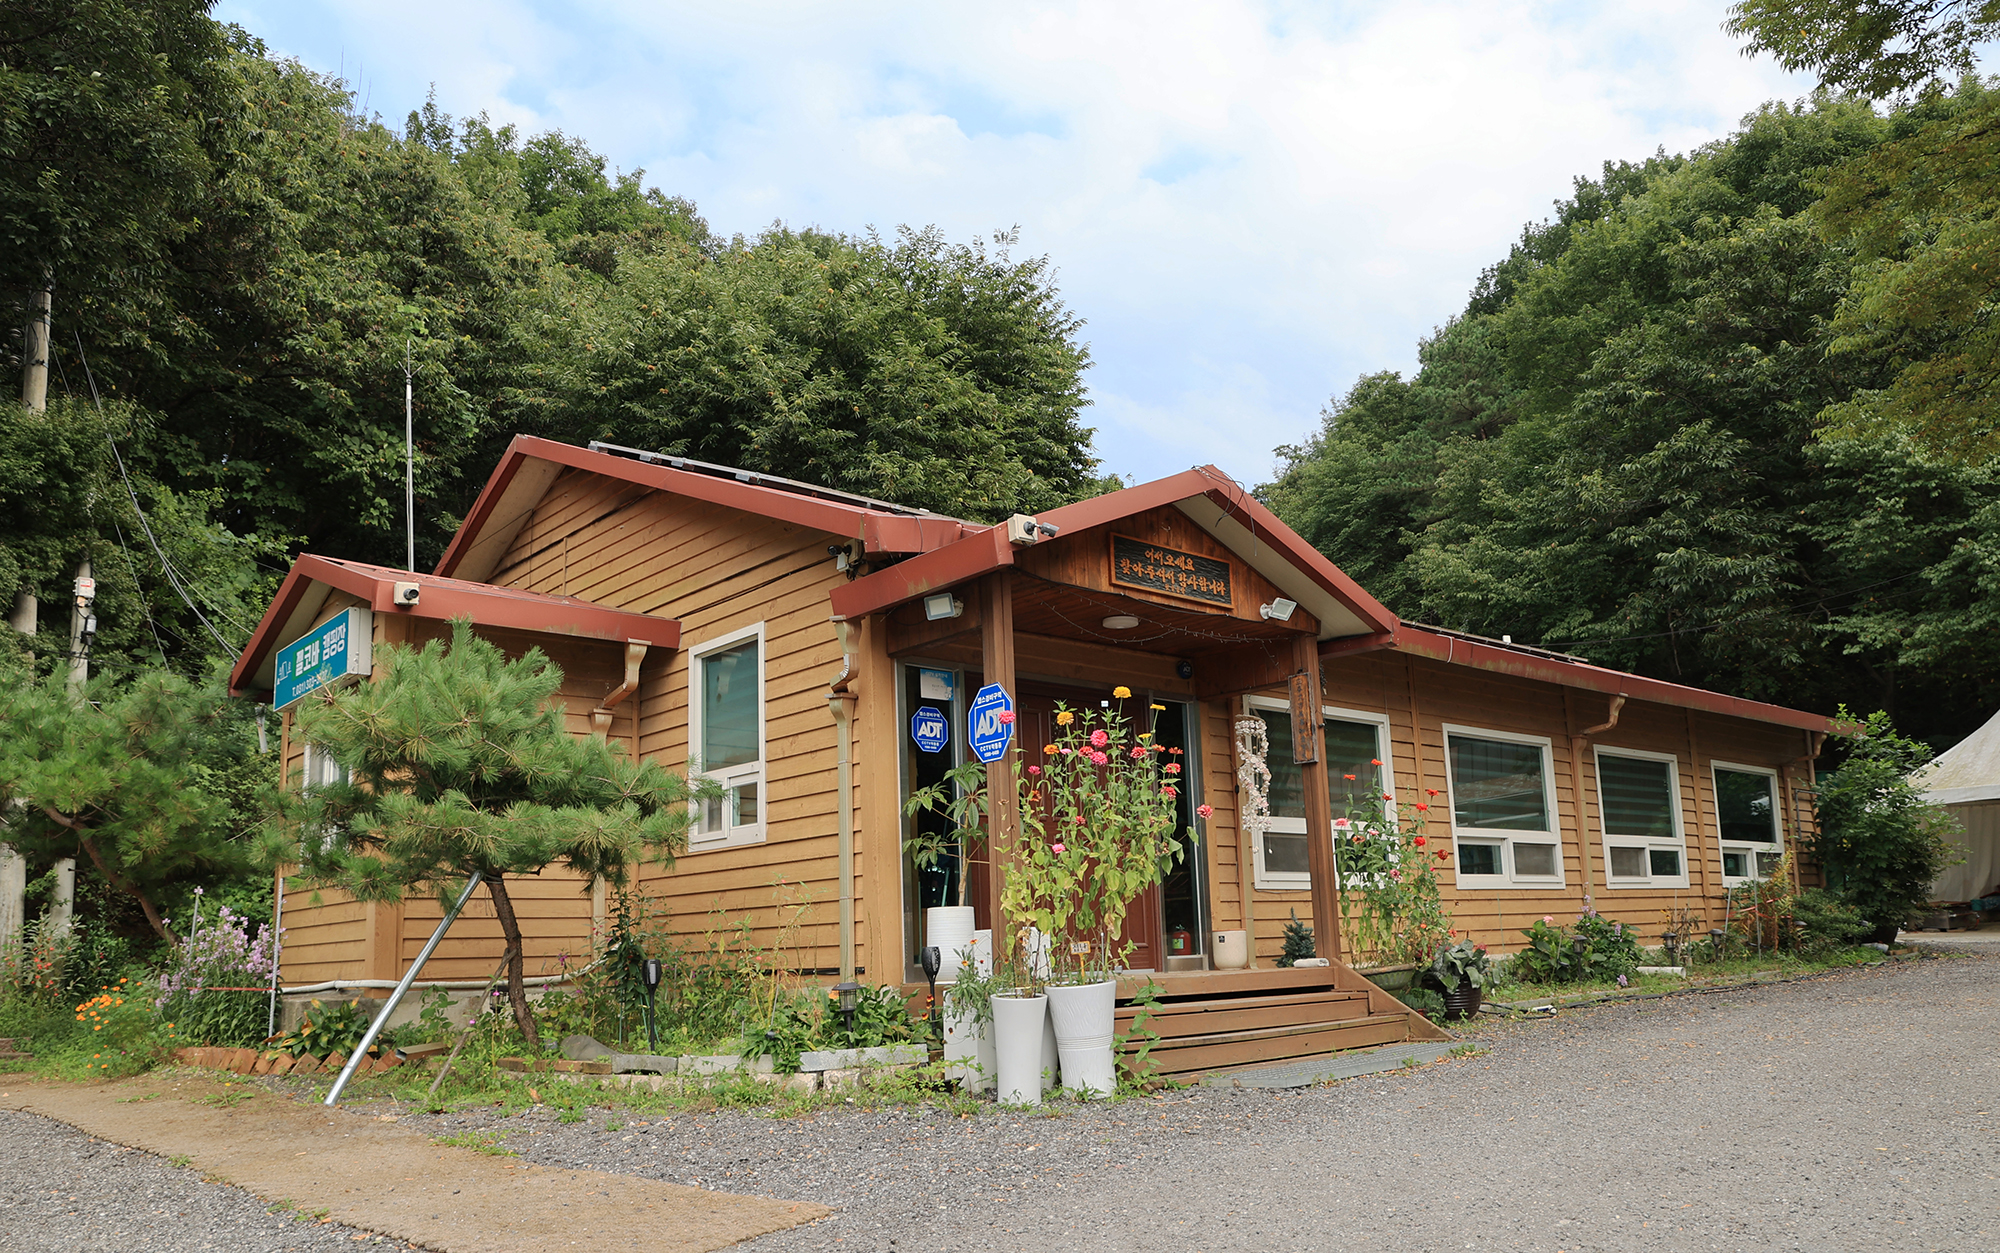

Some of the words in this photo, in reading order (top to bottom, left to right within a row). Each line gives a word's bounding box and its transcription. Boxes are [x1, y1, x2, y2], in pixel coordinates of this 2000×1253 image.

[1145, 548, 1195, 571] 어서오세요
[1178, 572, 1226, 596] 감사합니다
[322, 622, 346, 661] 캠핑장
[917, 721, 943, 739] ADT
[976, 706, 1003, 739] ADT
